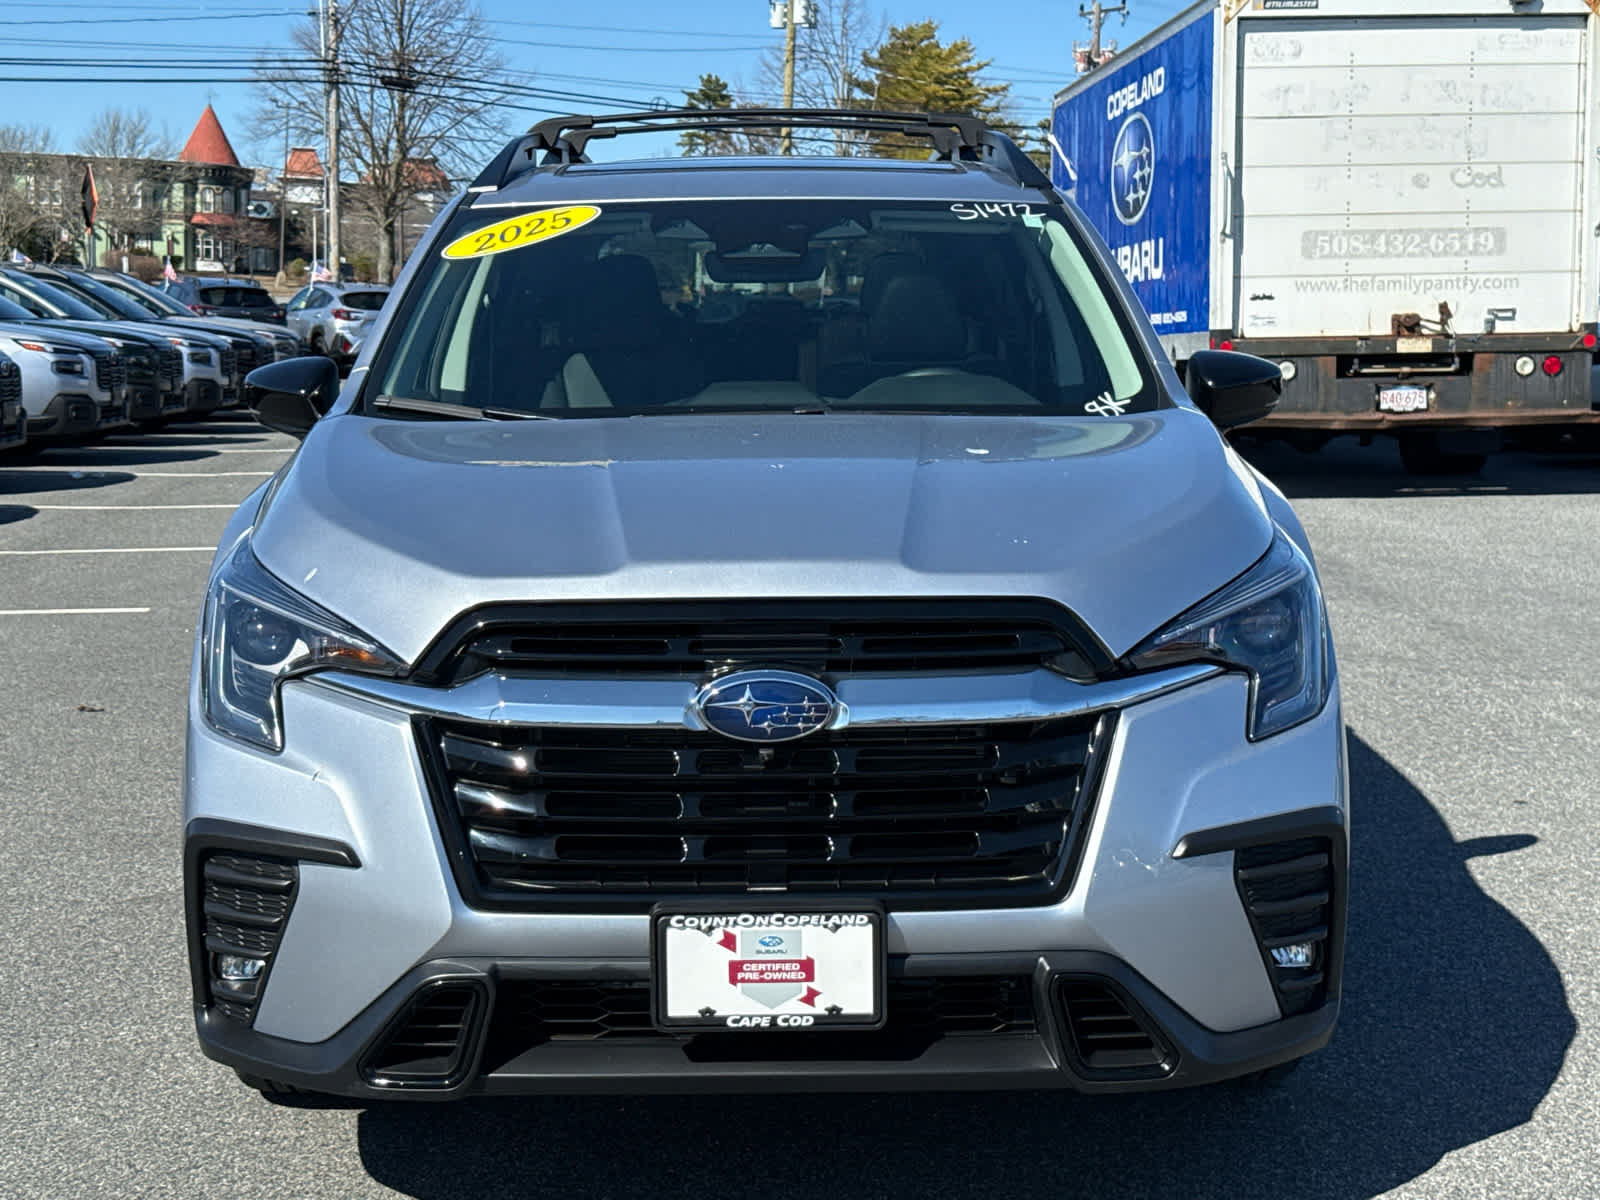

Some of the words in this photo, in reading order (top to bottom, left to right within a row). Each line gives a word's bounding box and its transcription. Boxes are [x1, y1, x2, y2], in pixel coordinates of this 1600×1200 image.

[1107, 66, 1165, 120] COPELAND
[474, 210, 572, 253] 2025
[1316, 230, 1496, 255] 508-432-6519
[1295, 275, 1520, 294] www.thefamilypantry.com
[737, 971, 806, 980] PRE-OWNED
[742, 962, 801, 972] CERTIFIED
[726, 1015, 771, 1027] CAPE
[776, 1015, 815, 1027] COD
